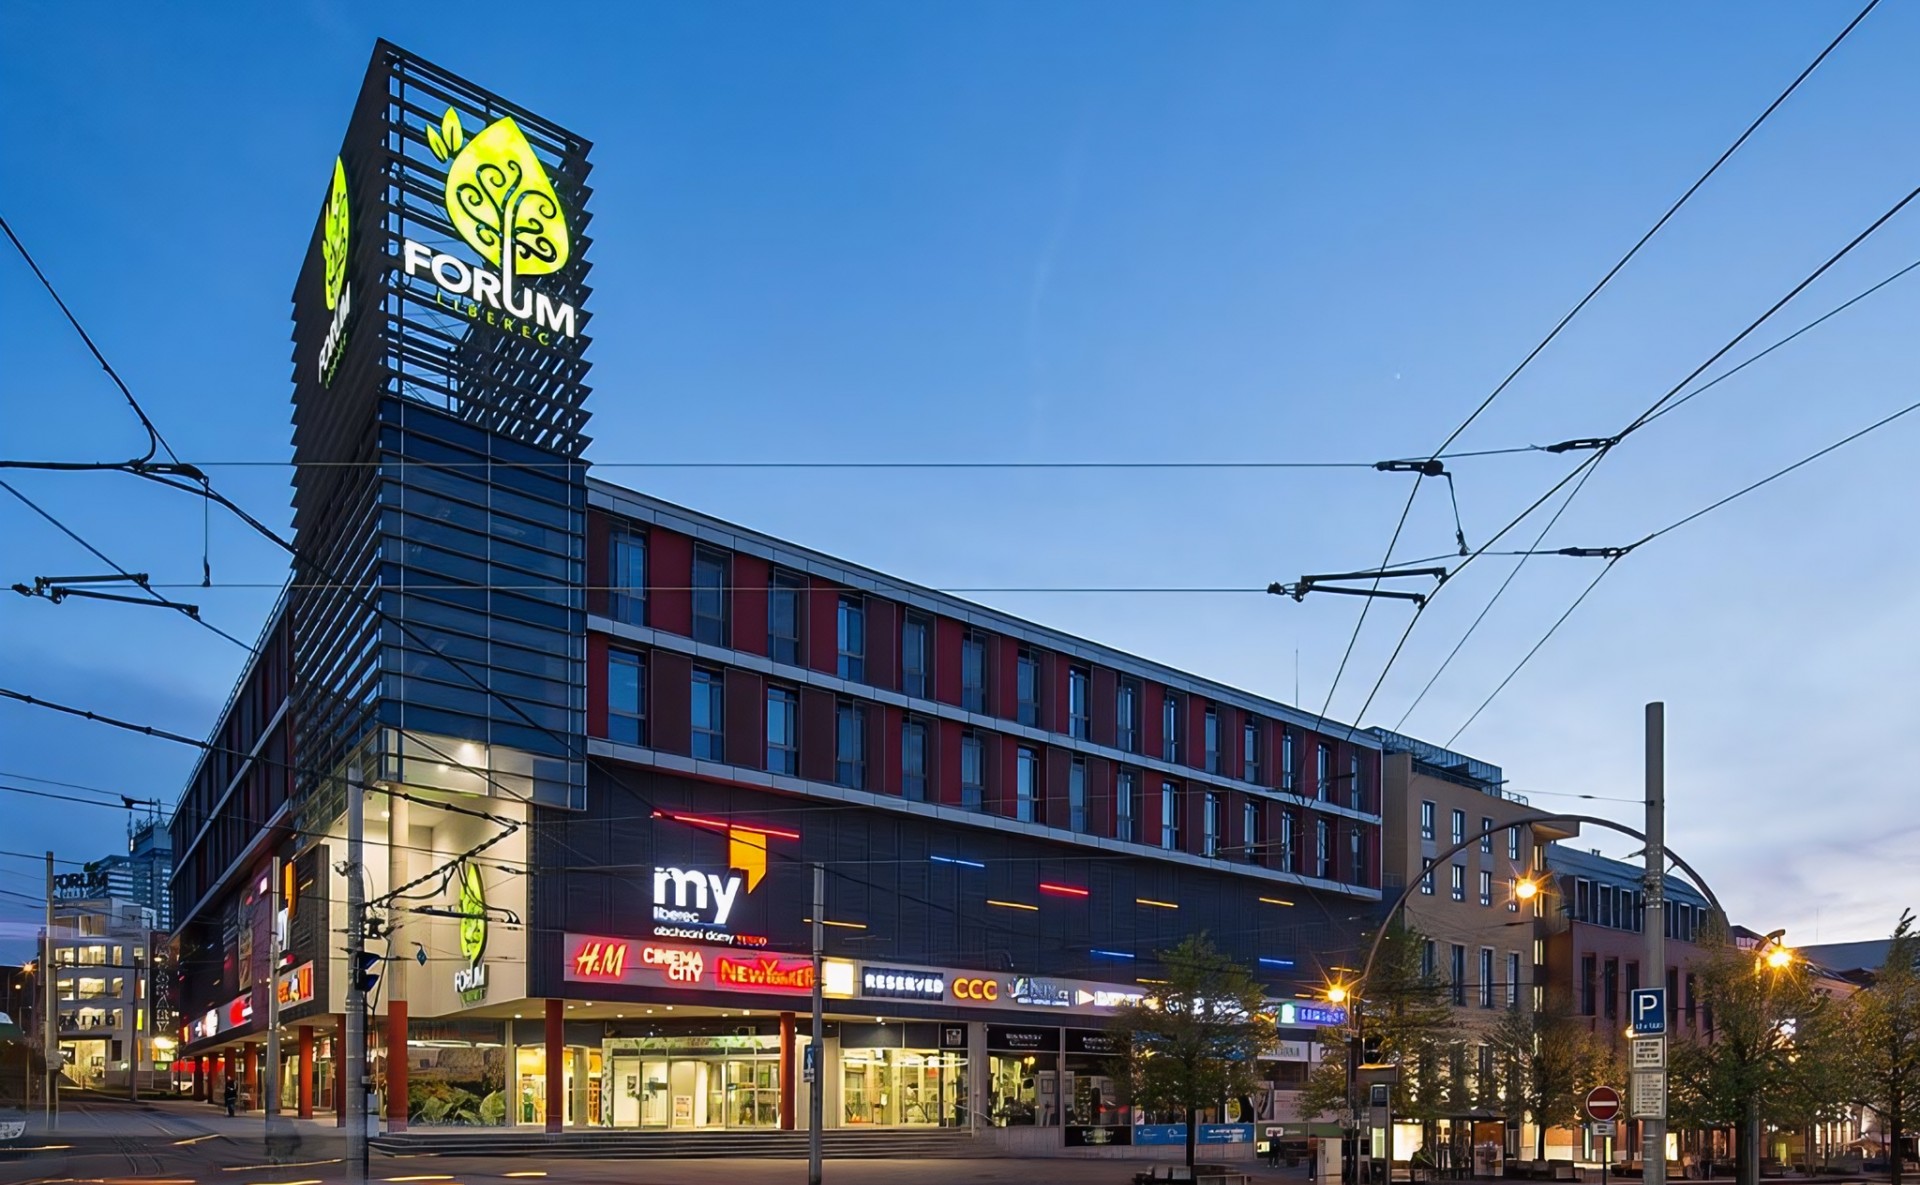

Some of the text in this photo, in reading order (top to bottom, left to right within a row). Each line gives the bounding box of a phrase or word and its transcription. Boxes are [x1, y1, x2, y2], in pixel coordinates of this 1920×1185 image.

[404, 238, 575, 339] FORUM
[436, 291, 550, 346] LIBEREC
[653, 866, 742, 925] my
[575, 942, 627, 977] H&M
[643, 947, 703, 967] CINEMA
[668, 963, 703, 982] CITY
[864, 973, 944, 993] RESERVED
[953, 977, 998, 1001] CCC
[1639, 994, 1658, 1021] P
